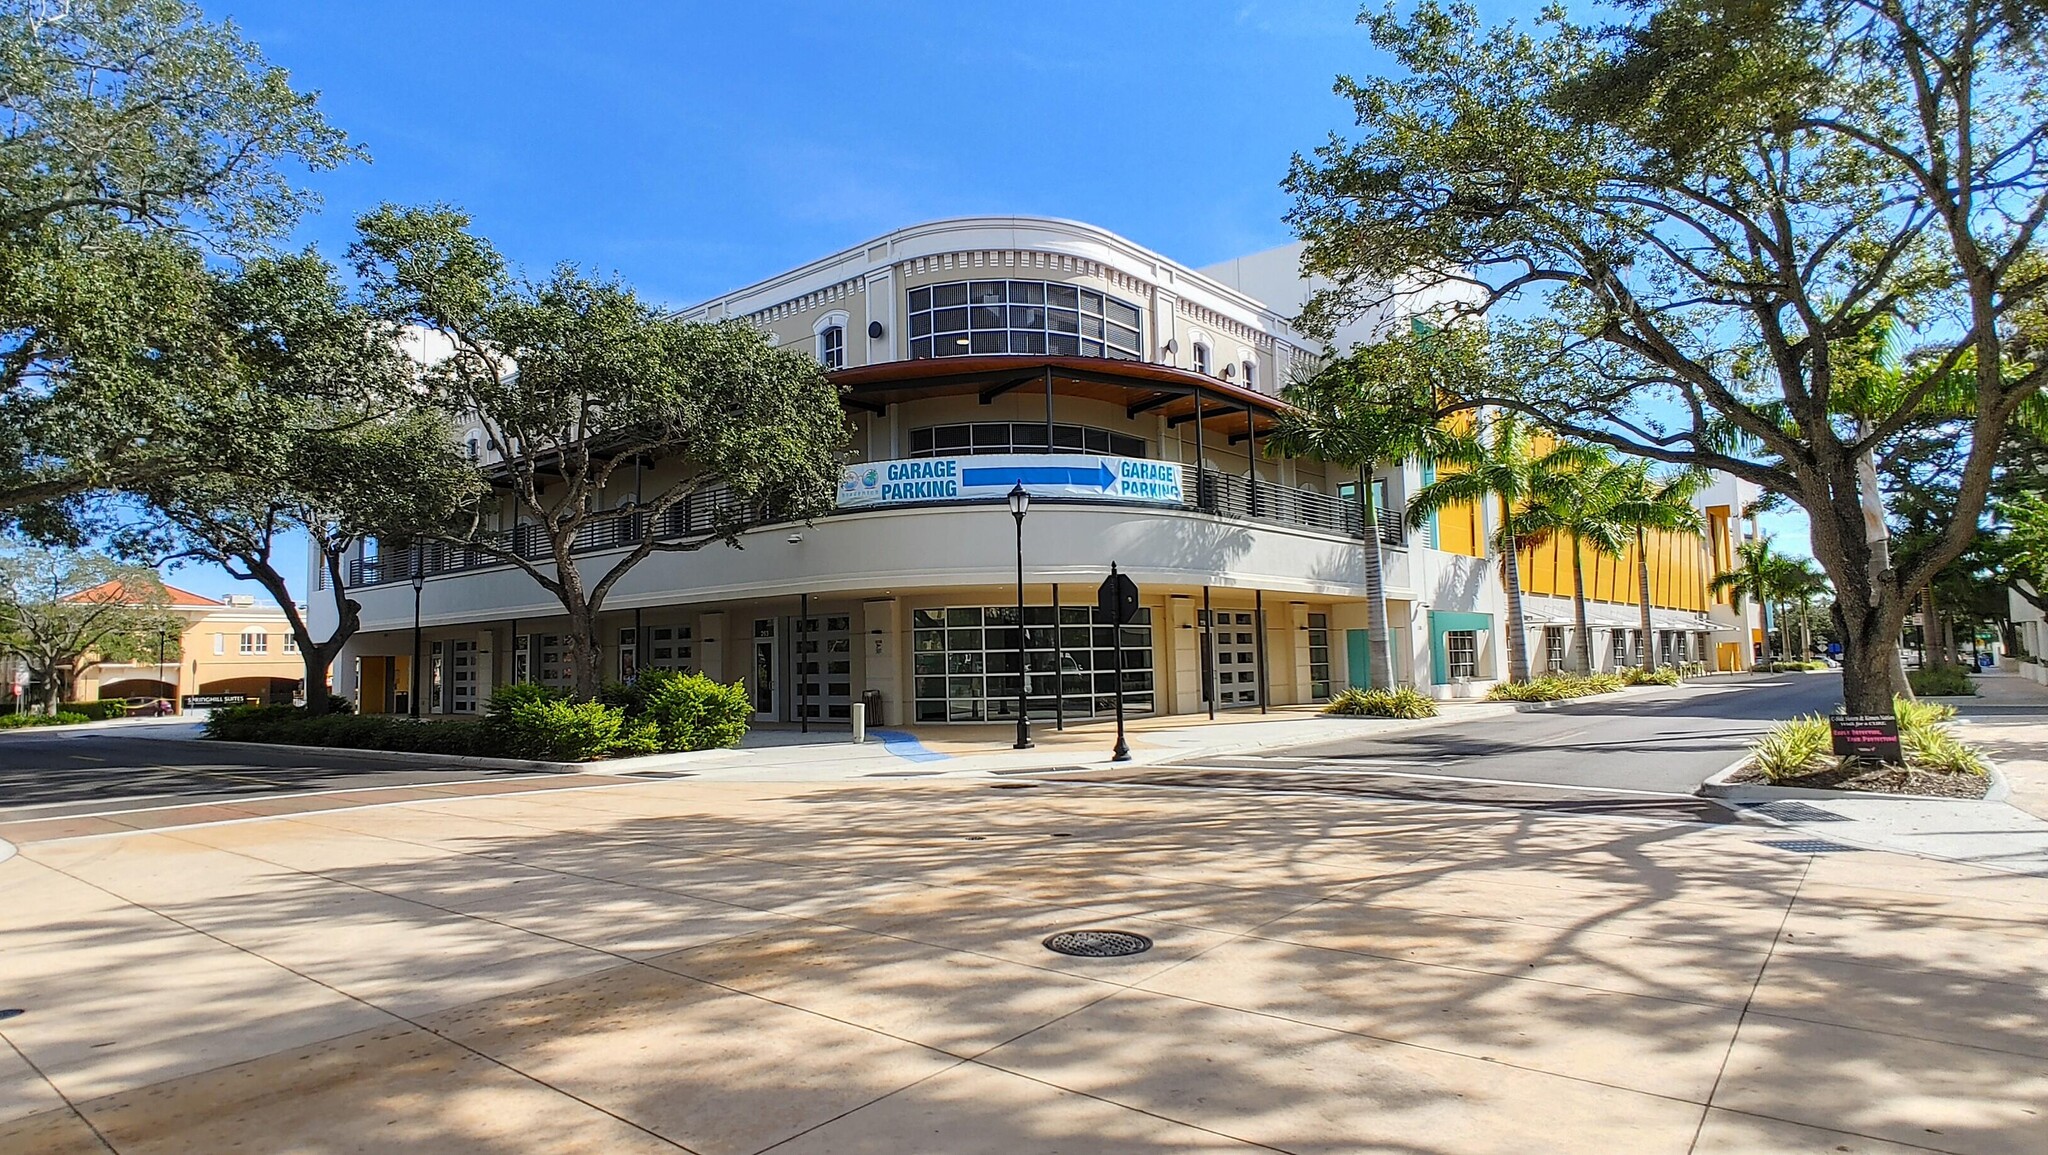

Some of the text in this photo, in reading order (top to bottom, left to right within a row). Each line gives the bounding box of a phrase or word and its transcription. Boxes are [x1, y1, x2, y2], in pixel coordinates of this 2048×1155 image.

[888, 461, 957, 481] GARAGE
[1121, 461, 1173, 482] GARAGE
[881, 480, 957, 500] PARKING
[1121, 480, 1179, 499] PARKING
